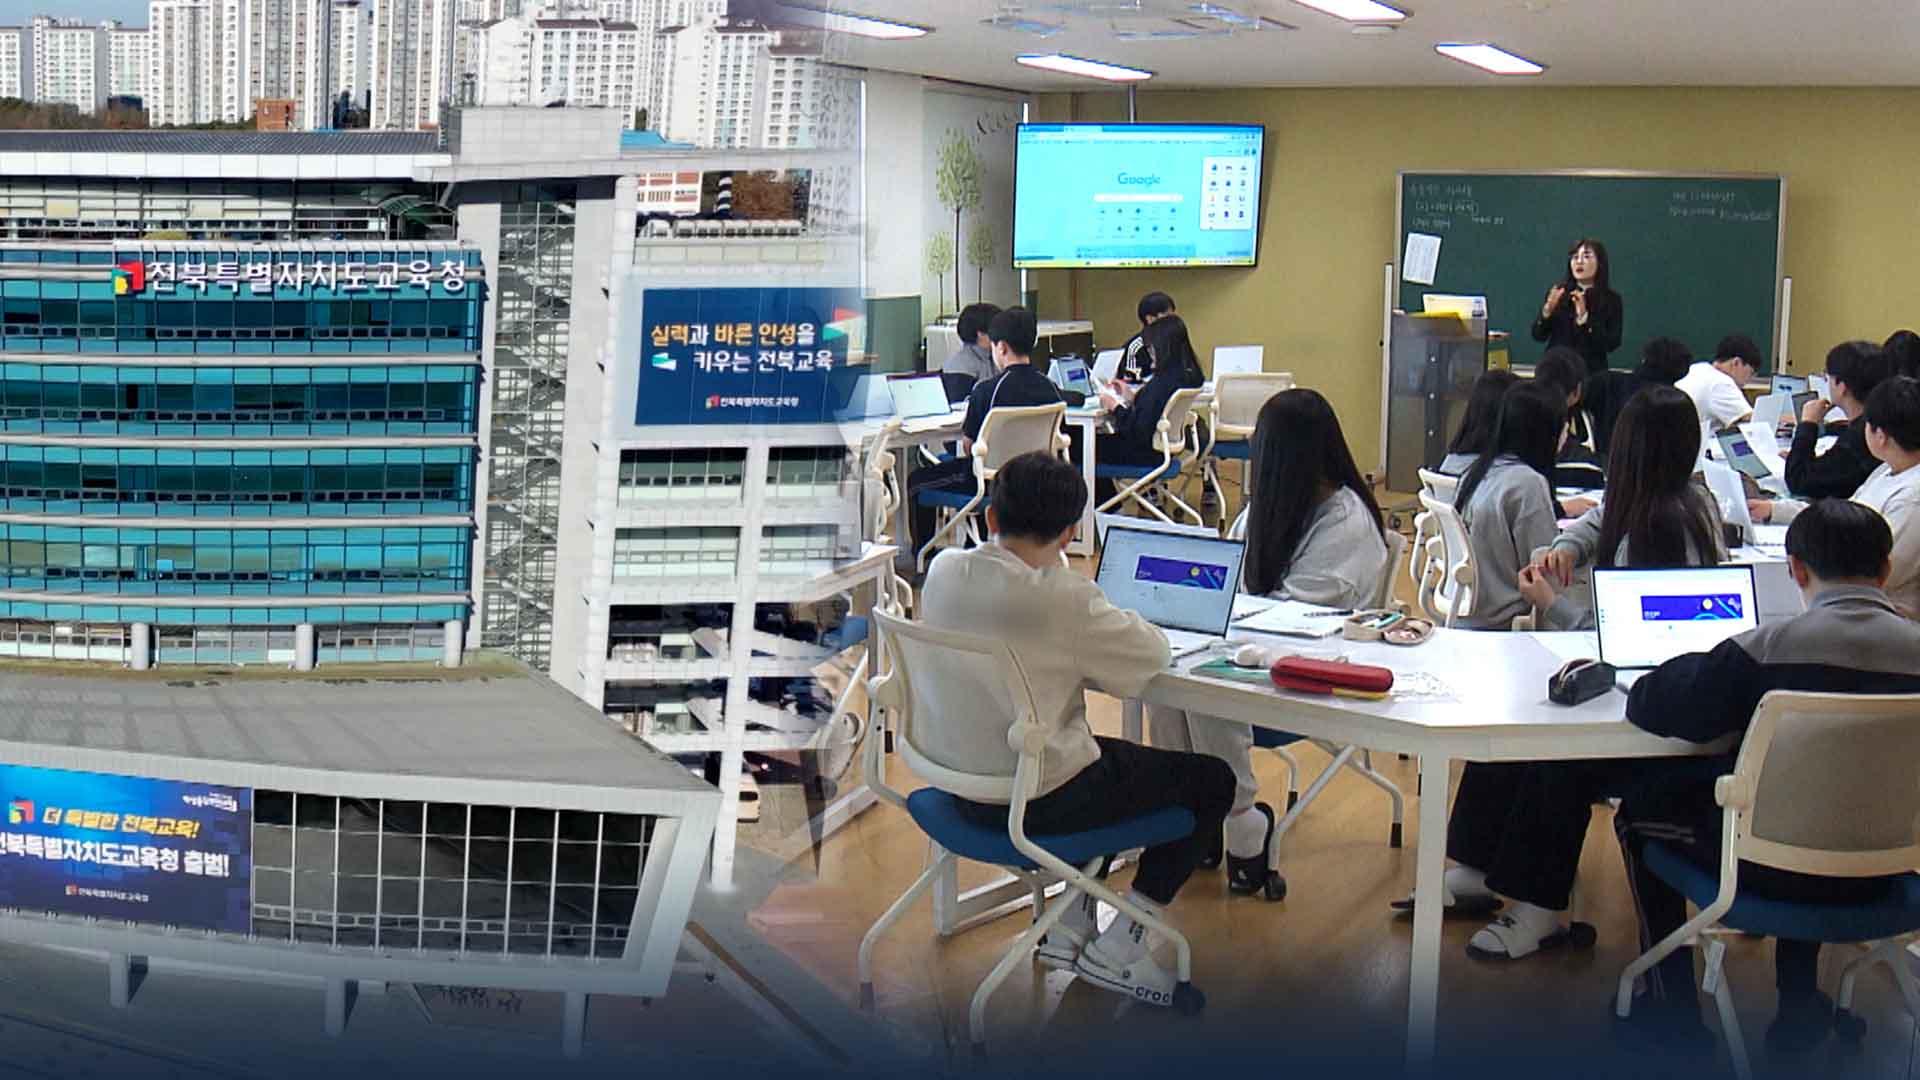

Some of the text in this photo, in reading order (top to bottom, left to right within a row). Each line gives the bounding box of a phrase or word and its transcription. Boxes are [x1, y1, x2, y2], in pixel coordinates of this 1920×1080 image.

[1118, 172, 1160, 188] Google
[149, 260, 465, 293] 전북특별자치도교육청
[651, 322, 815, 347] 실력과 바른 인성을
[693, 350, 833, 372] 키우는 전북교육
[43, 806, 200, 839] 더 특별한 전북교육!
[183, 849, 231, 877] 출범!
